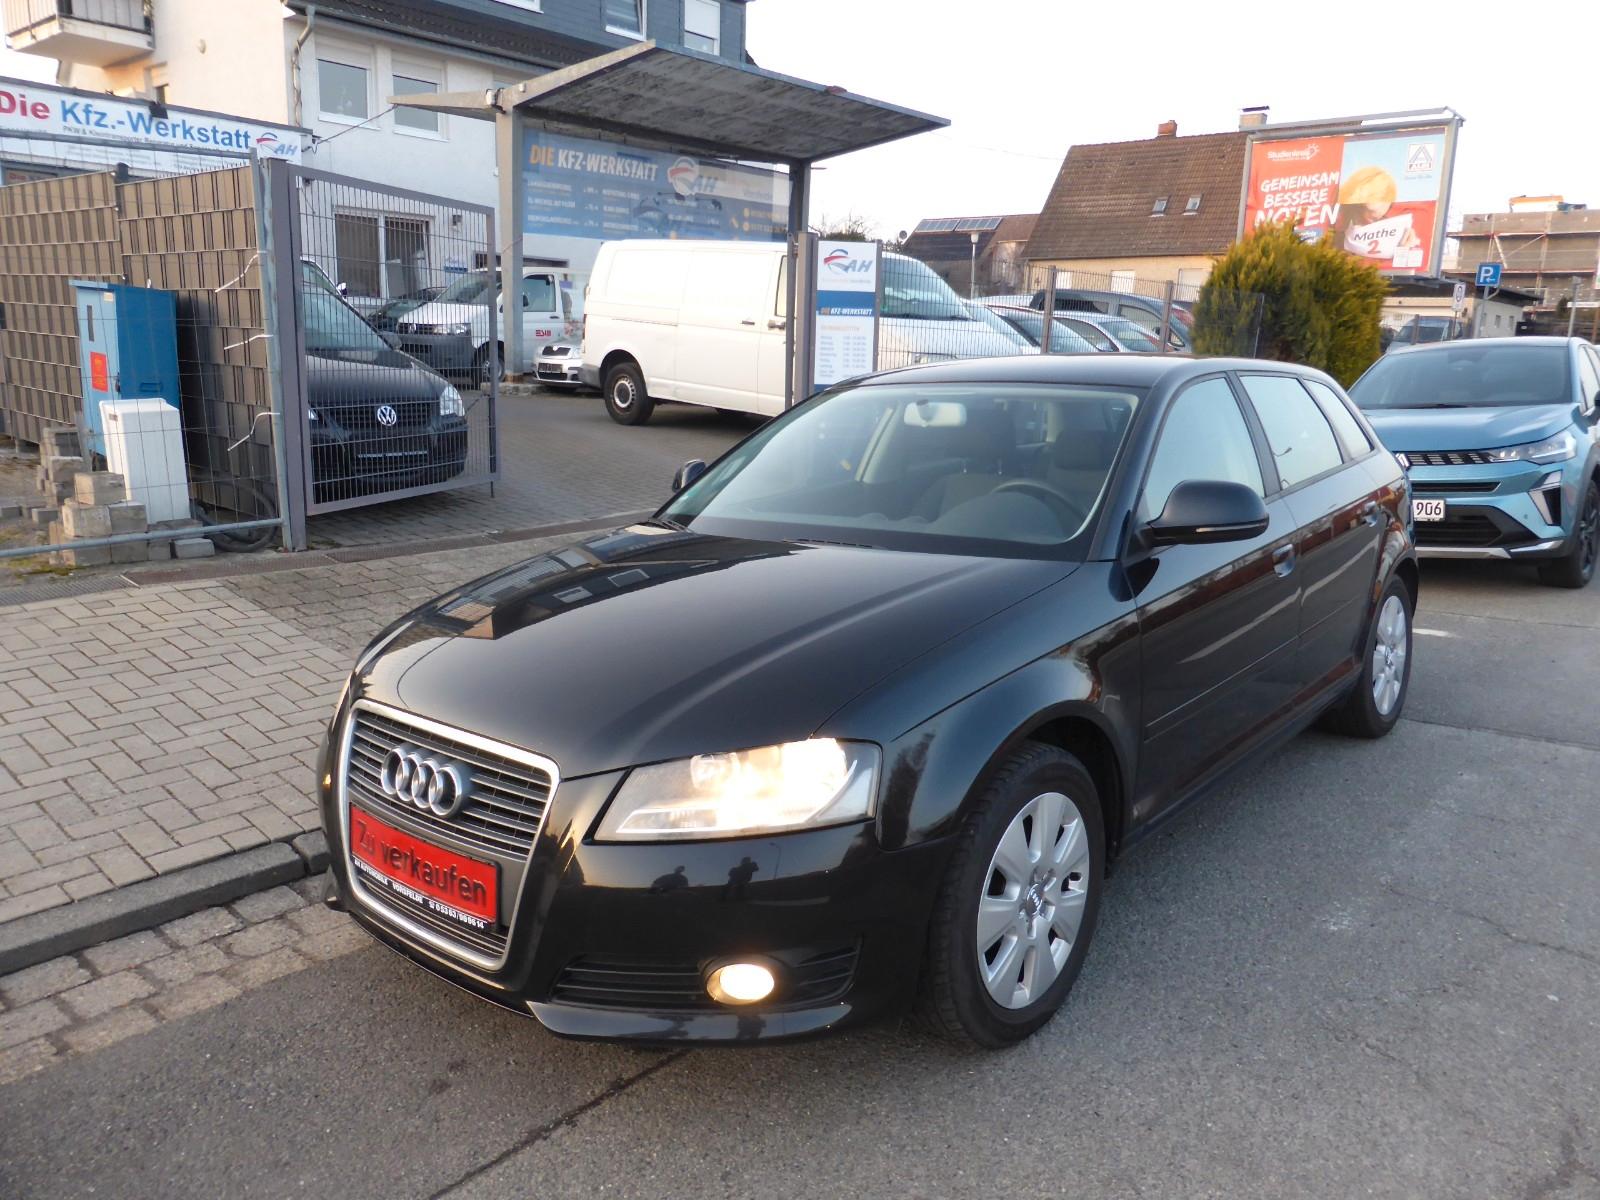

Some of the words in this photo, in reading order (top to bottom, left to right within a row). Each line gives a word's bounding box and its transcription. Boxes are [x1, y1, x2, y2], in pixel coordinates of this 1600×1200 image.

[0, 90, 50, 119] Die
[60, 99, 251, 149] Kfz.-Werkstatt
[529, 144, 554, 168] DIE
[558, 149, 659, 181] KFZ-WERKSTATT
[1261, 171, 1340, 192] GEMEINSAM
[1264, 188, 1328, 208] BESSERE
[1354, 228, 1397, 242] Mathe
[1368, 240, 1381, 255] 2
[847, 259, 873, 273] AH
[1480, 266, 1494, 283] P
[1416, 502, 1442, 516] 906
[380, 840, 487, 908] verkaufen
